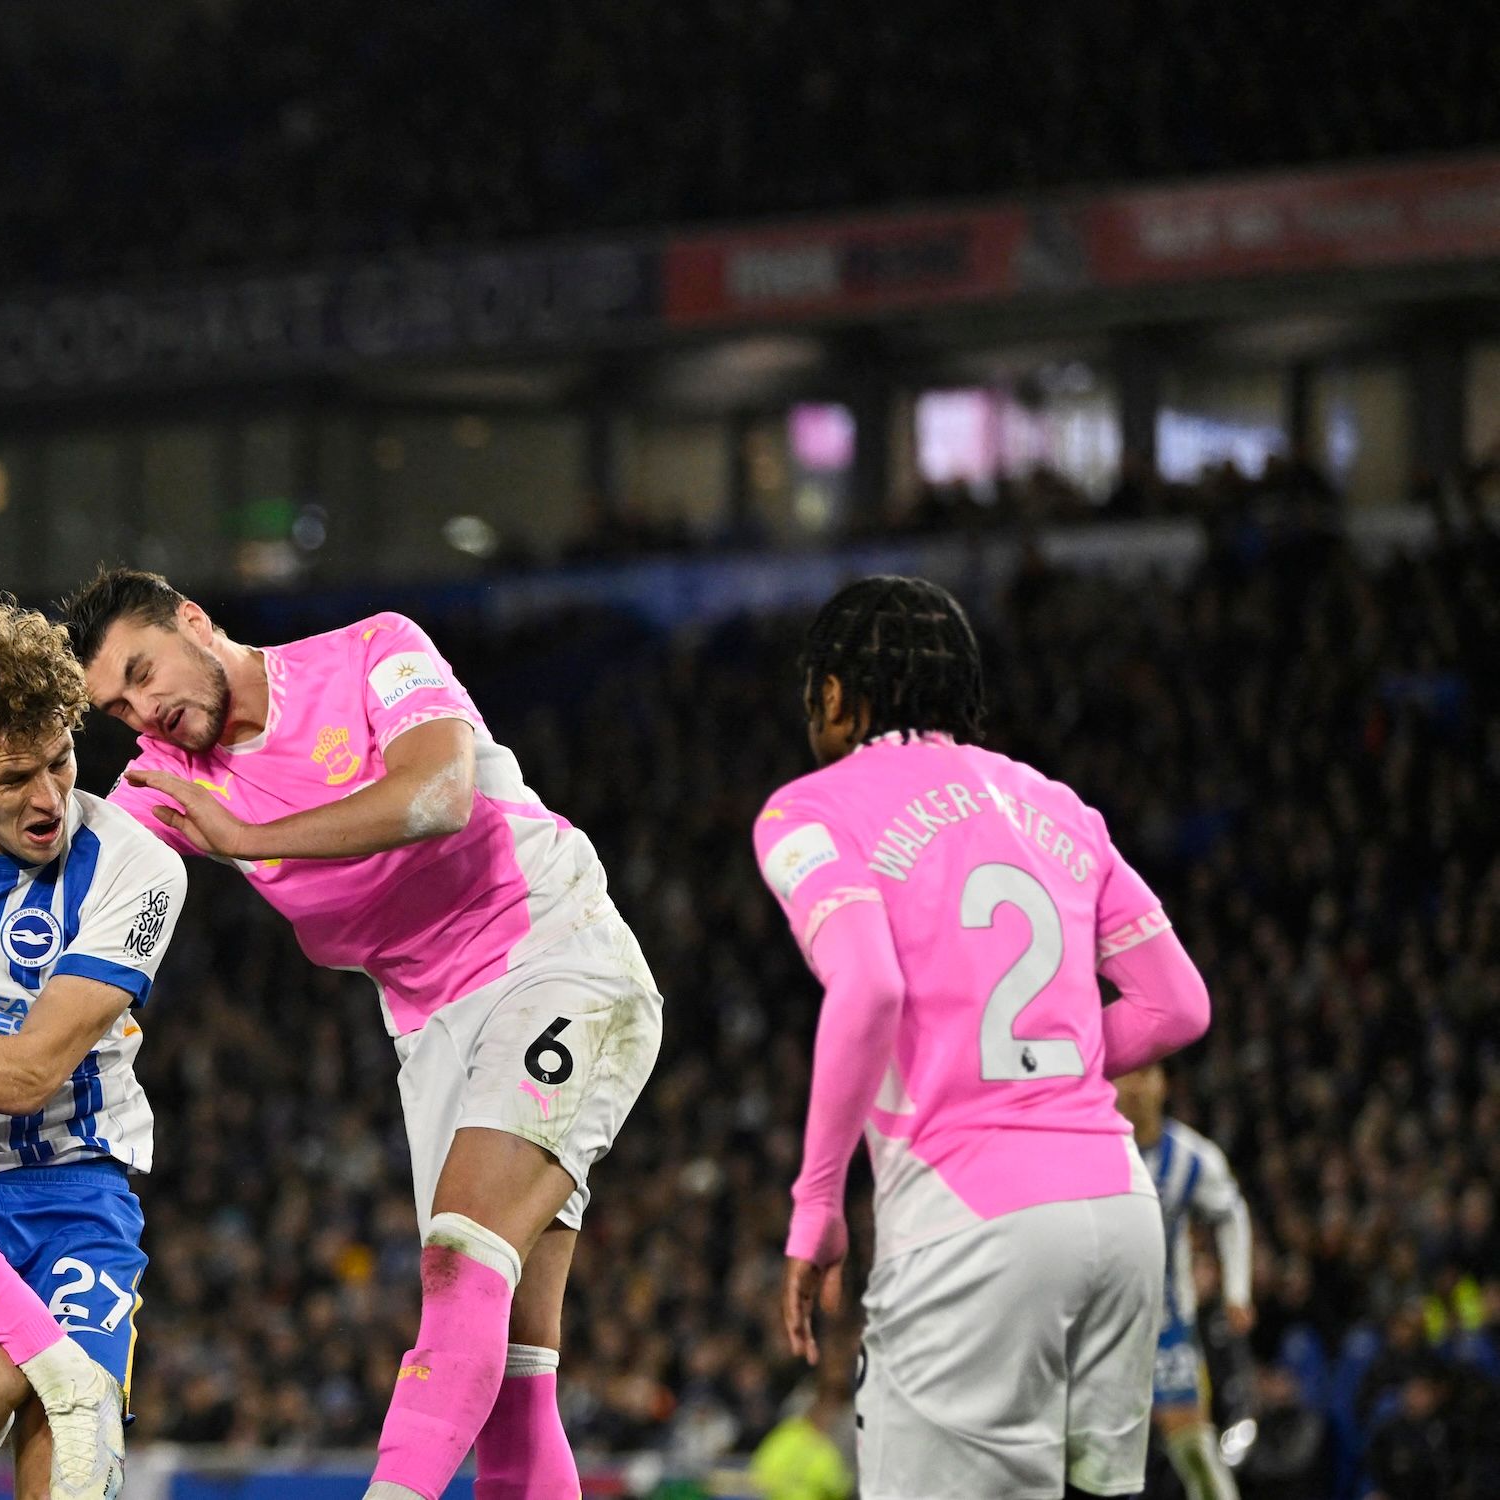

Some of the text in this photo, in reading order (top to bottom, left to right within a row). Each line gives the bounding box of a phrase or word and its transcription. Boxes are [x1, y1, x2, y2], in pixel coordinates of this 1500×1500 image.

[383, 687, 404, 706] P&O
[868, 782, 1094, 883] WALKER-ETERS
[10, 909, 39, 923] BRIGHTON
[45, 916, 57, 929] HOVE
[16, 957, 38, 965] ALBION
[960, 862, 1085, 1081] 2
[524, 1017, 574, 1085] 6
[49, 1256, 134, 1333] 27
